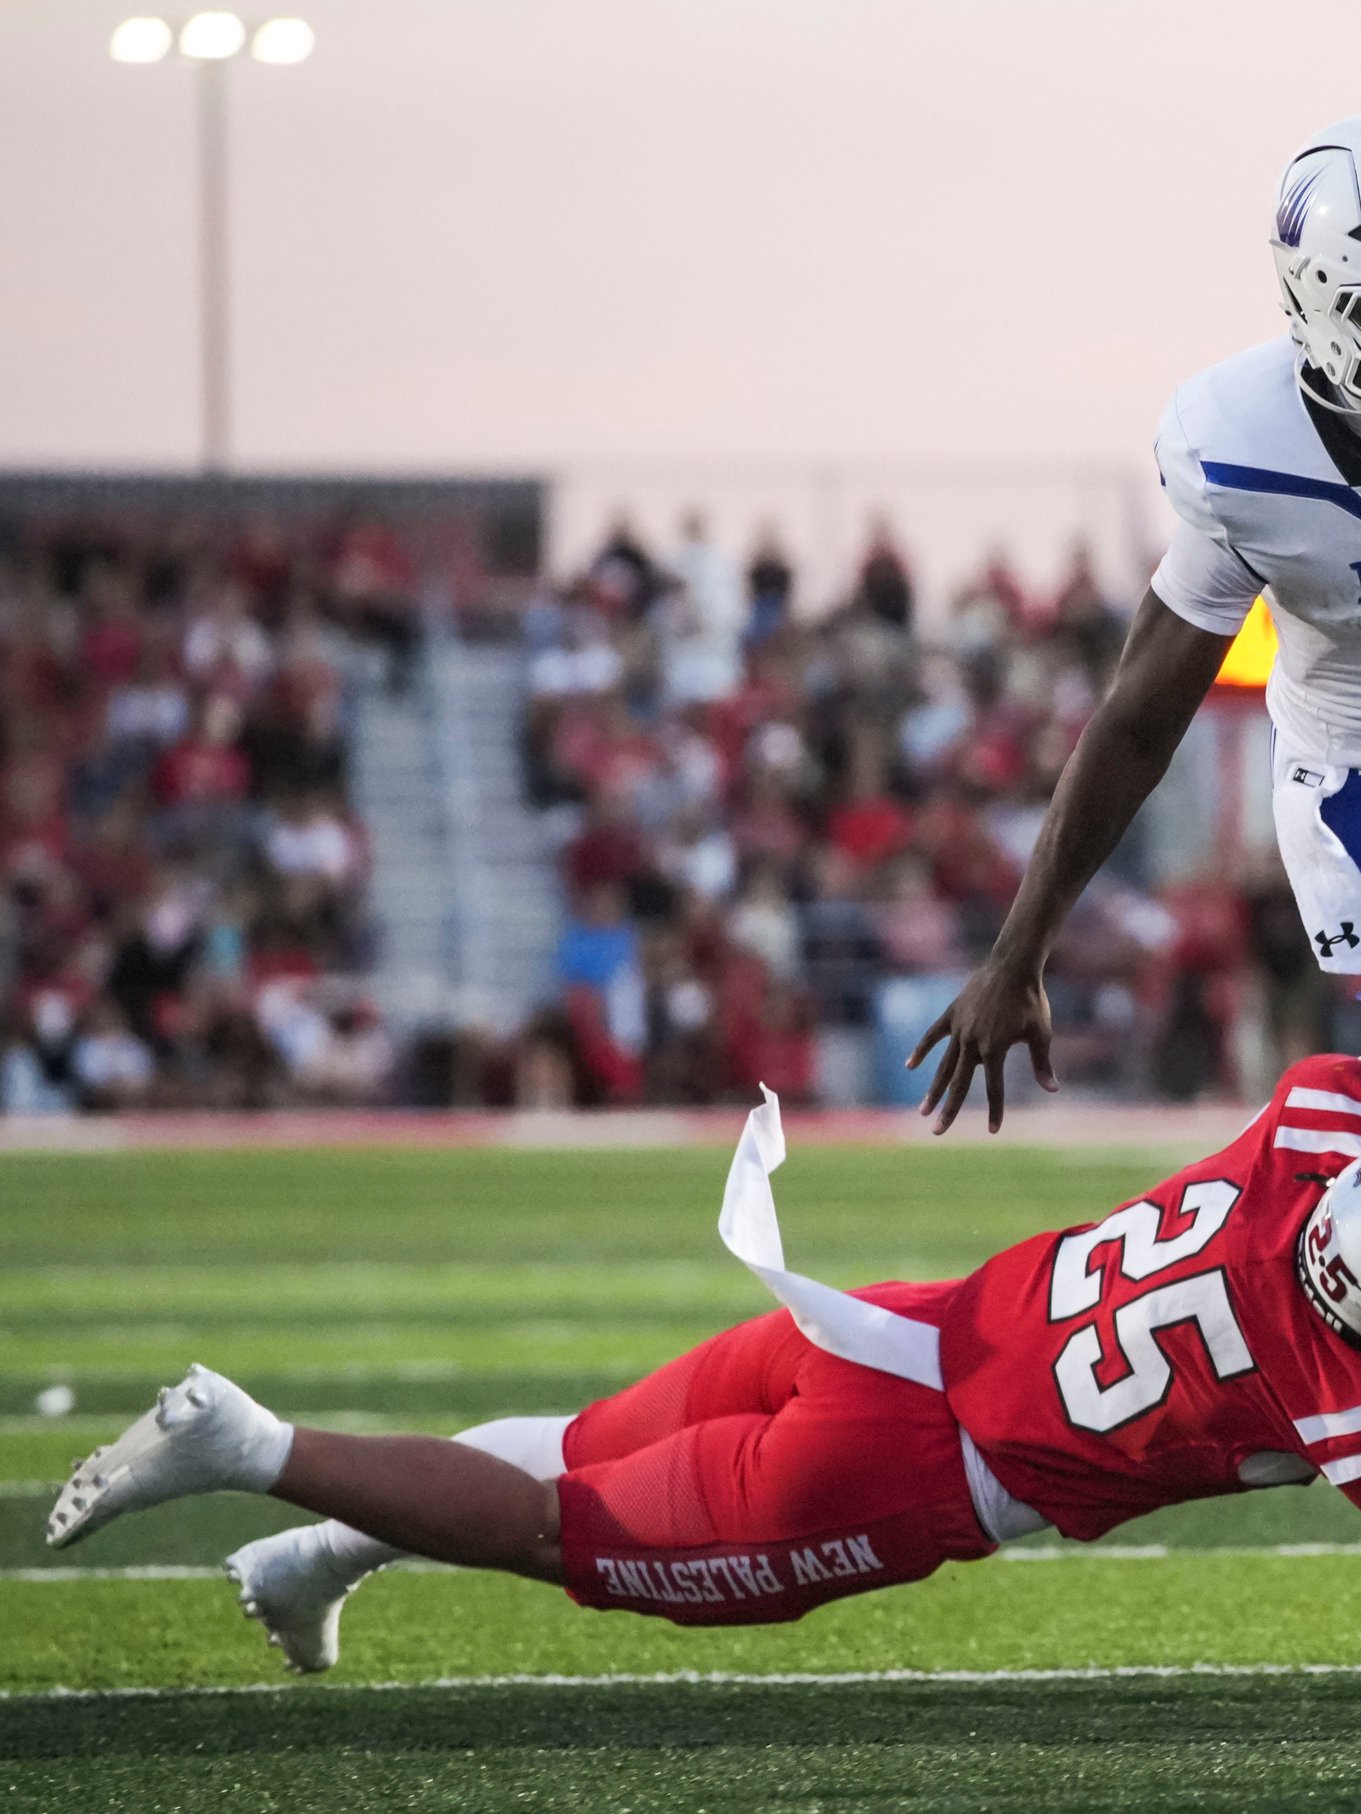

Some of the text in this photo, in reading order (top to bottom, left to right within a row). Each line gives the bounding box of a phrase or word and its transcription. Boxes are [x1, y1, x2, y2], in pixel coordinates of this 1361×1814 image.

[1308, 1214, 1360, 1303] 25
[1048, 1178, 1260, 1435] 25
[595, 1534, 884, 1603] NEW PALESTINE
